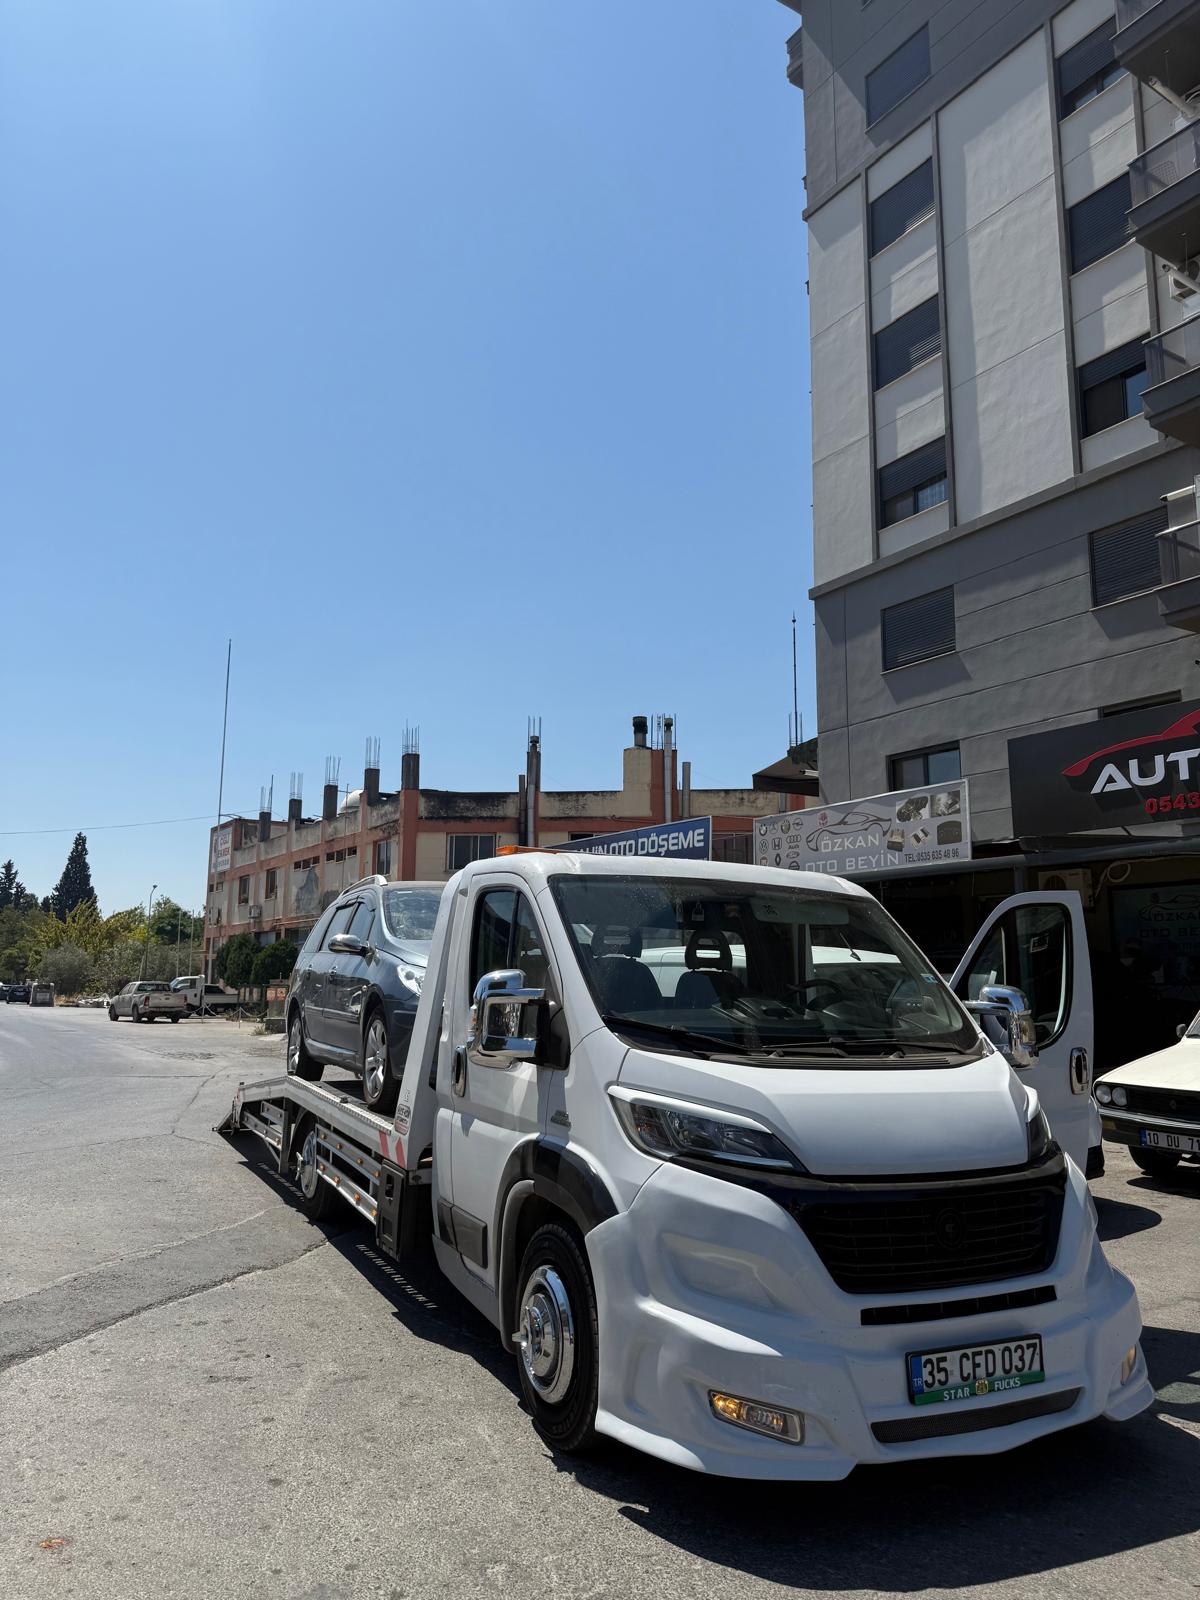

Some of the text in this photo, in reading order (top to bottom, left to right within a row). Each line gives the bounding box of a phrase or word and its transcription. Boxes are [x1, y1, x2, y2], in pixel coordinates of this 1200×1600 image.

[1090, 748, 1200, 795] AUT
[637, 828, 705, 857] DÖŞEME
[821, 833, 880, 853] ÖZKAN
[805, 850, 899, 873] OTO BEYİN
[1147, 1132, 1159, 1145] 10
[922, 1342, 1039, 1389] 35 CFD 037
[913, 1378, 923, 1388] TR
[943, 1377, 1021, 1401] STAR FUCKS
